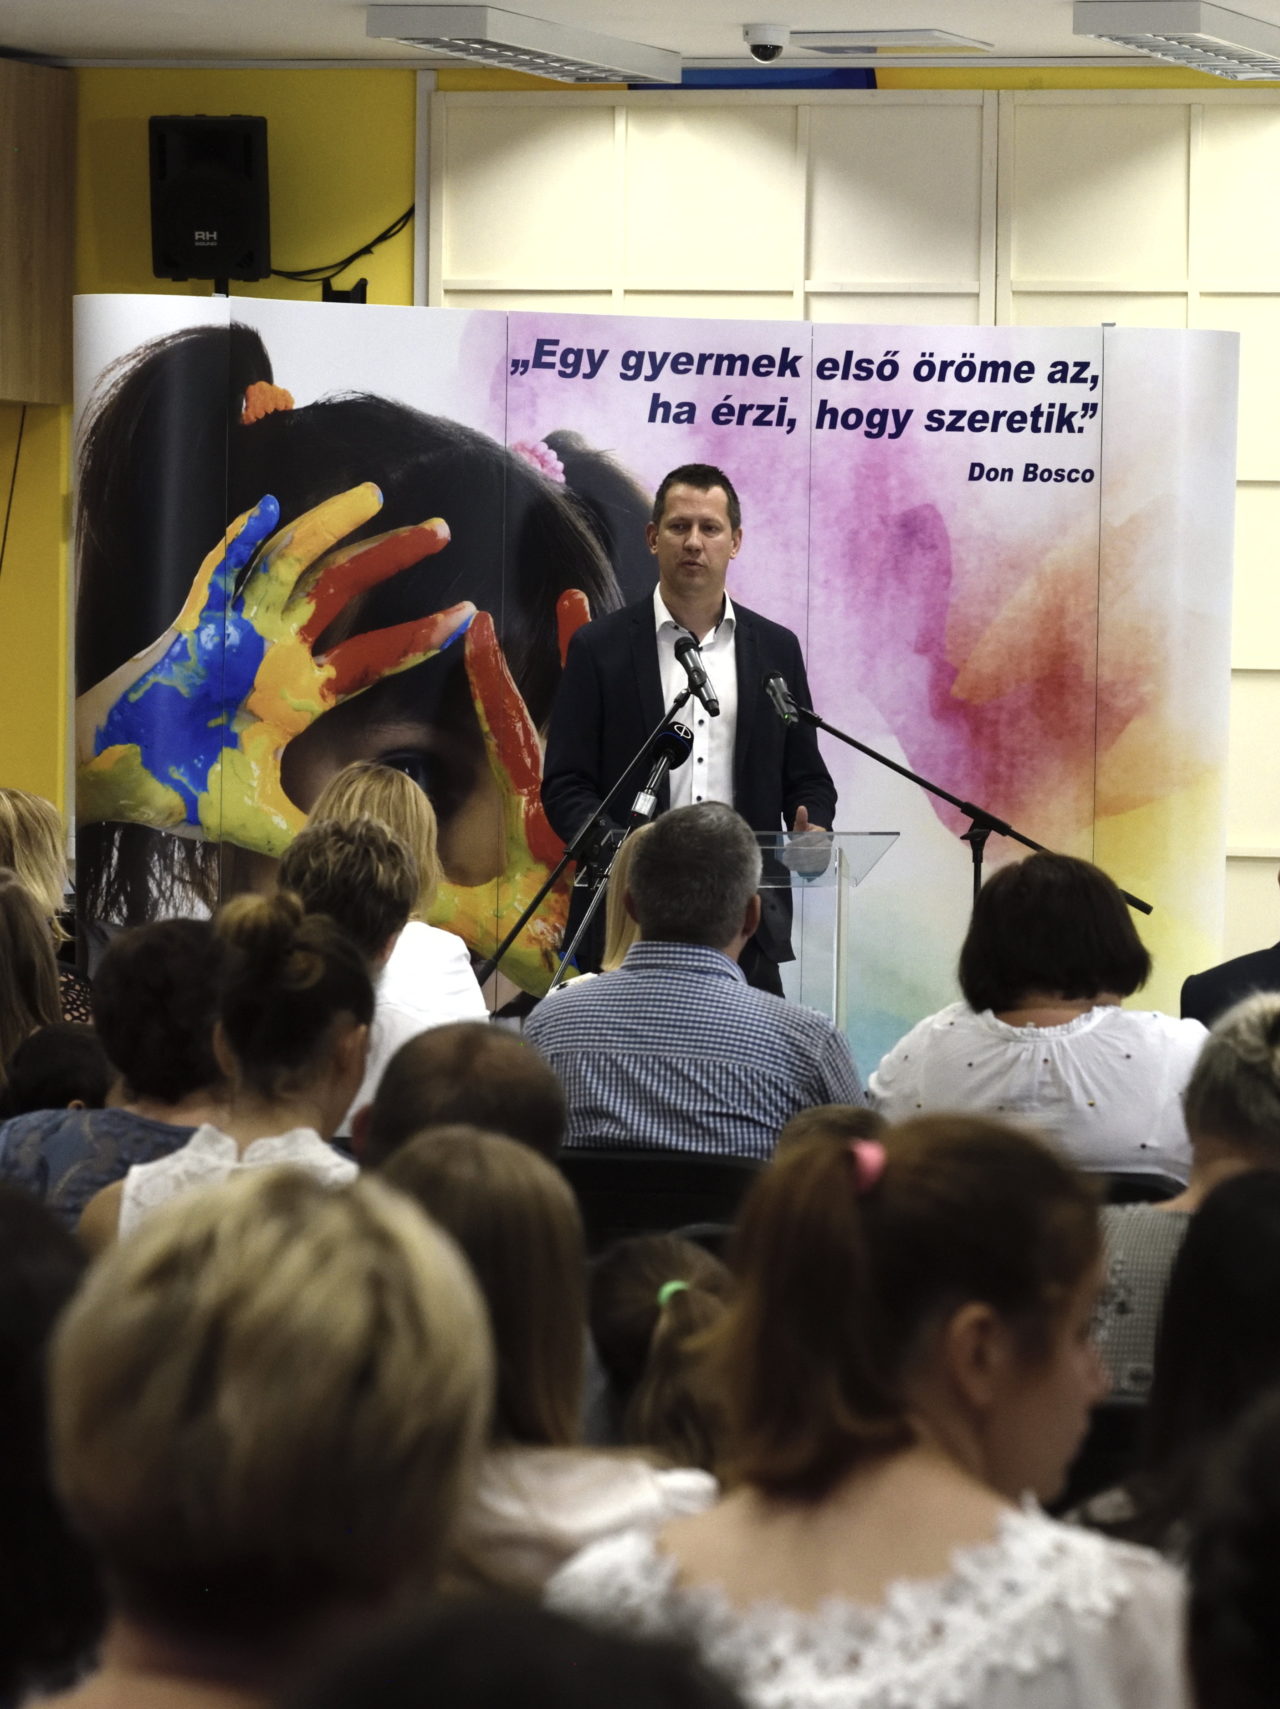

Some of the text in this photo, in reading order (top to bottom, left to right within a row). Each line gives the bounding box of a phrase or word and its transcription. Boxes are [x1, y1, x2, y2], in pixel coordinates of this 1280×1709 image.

[195, 231, 217, 241] RH
[509, 338, 1100, 392] „Egy gyermek első öröme az,
[647, 392, 698, 425] ha
[711, 394, 798, 435] érzi,
[815, 398, 914, 440] hogy
[967, 462, 1095, 484] Don Bosco
